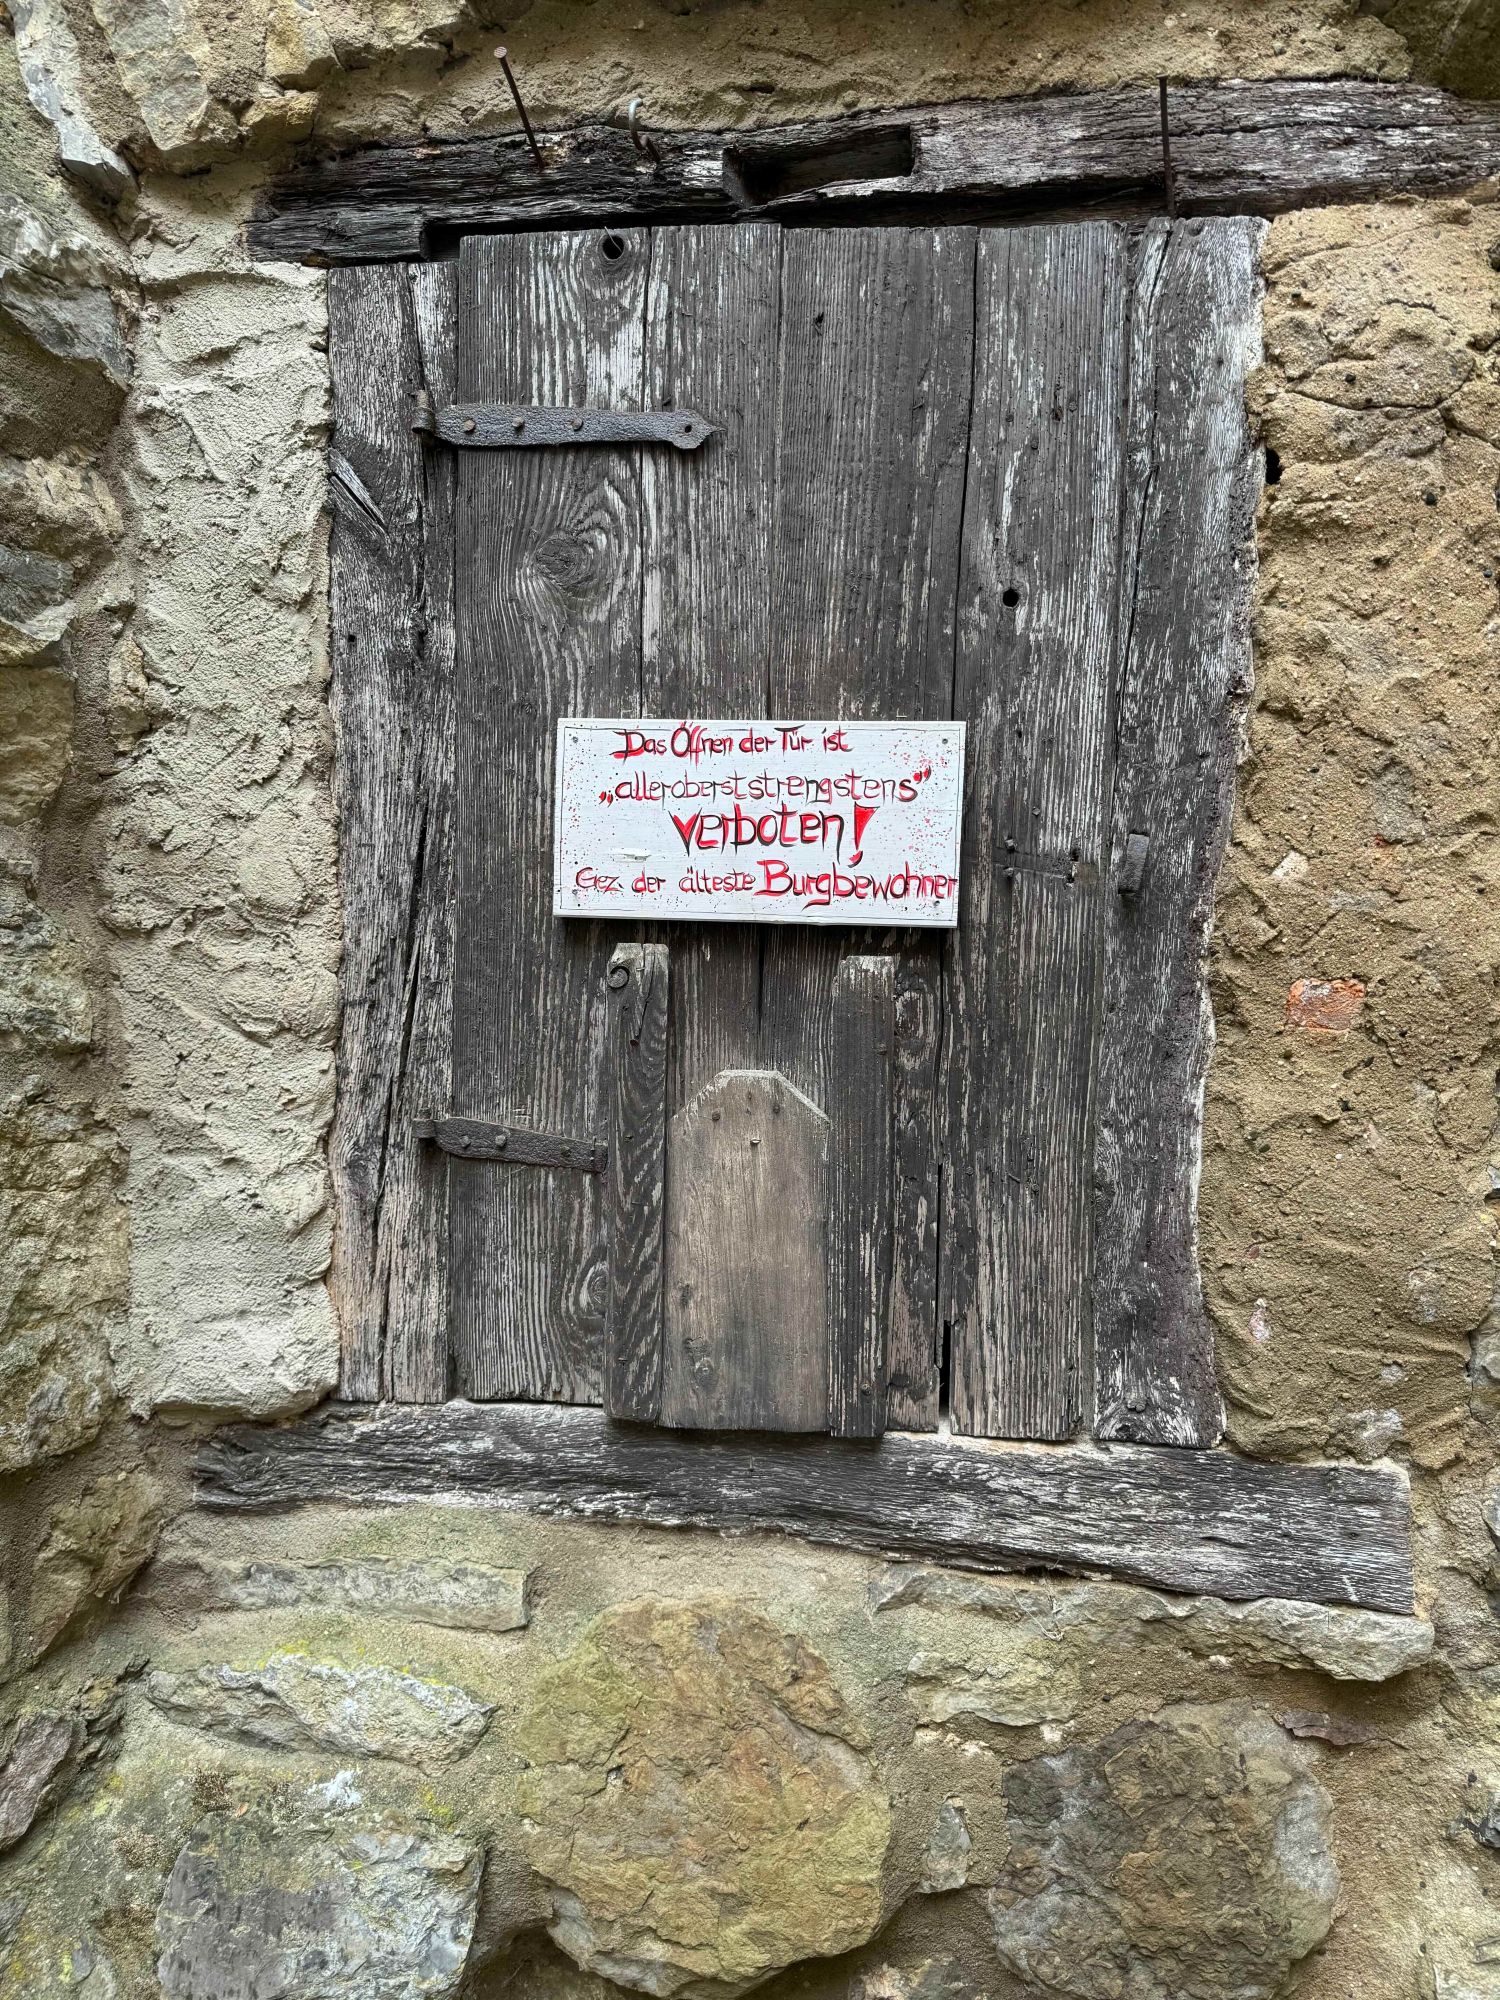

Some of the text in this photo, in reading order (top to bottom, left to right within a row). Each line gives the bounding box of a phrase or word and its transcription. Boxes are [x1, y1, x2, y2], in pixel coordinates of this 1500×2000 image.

[609, 721, 853, 766] Das Öffnen der Tür ist
[631, 868, 667, 894] der
[678, 866, 756, 894] älteste
[753, 859, 958, 911] Burgbewohner
